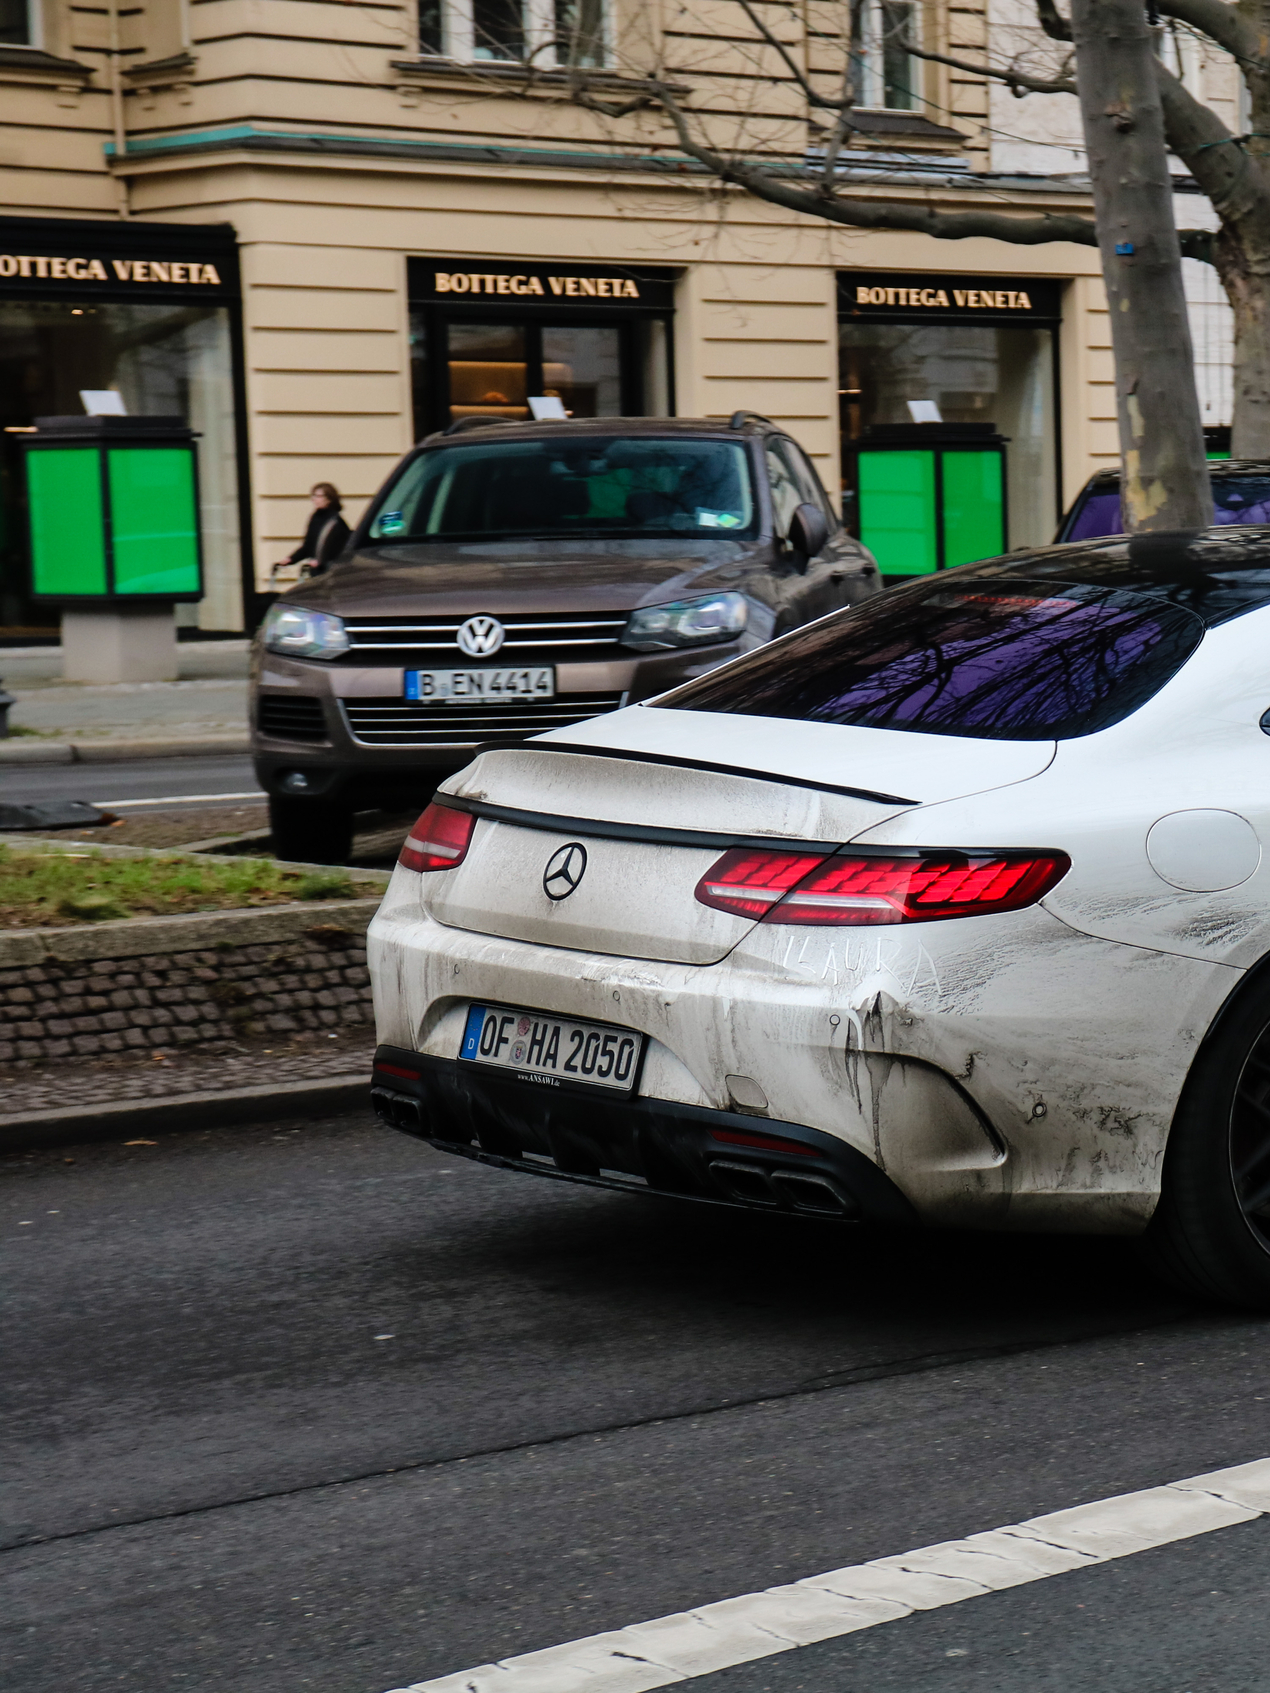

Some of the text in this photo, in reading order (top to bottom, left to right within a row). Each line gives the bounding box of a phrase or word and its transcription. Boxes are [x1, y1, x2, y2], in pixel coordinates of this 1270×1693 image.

[0, 254, 221, 285] OTTEGA VENETA
[435, 272, 640, 298] BOTTEGA VENETA
[856, 286, 1032, 309] BOTTEGA VENETA
[421, 670, 548, 696] B EN 4414
[479, 1014, 635, 1081] OF HA 2050
